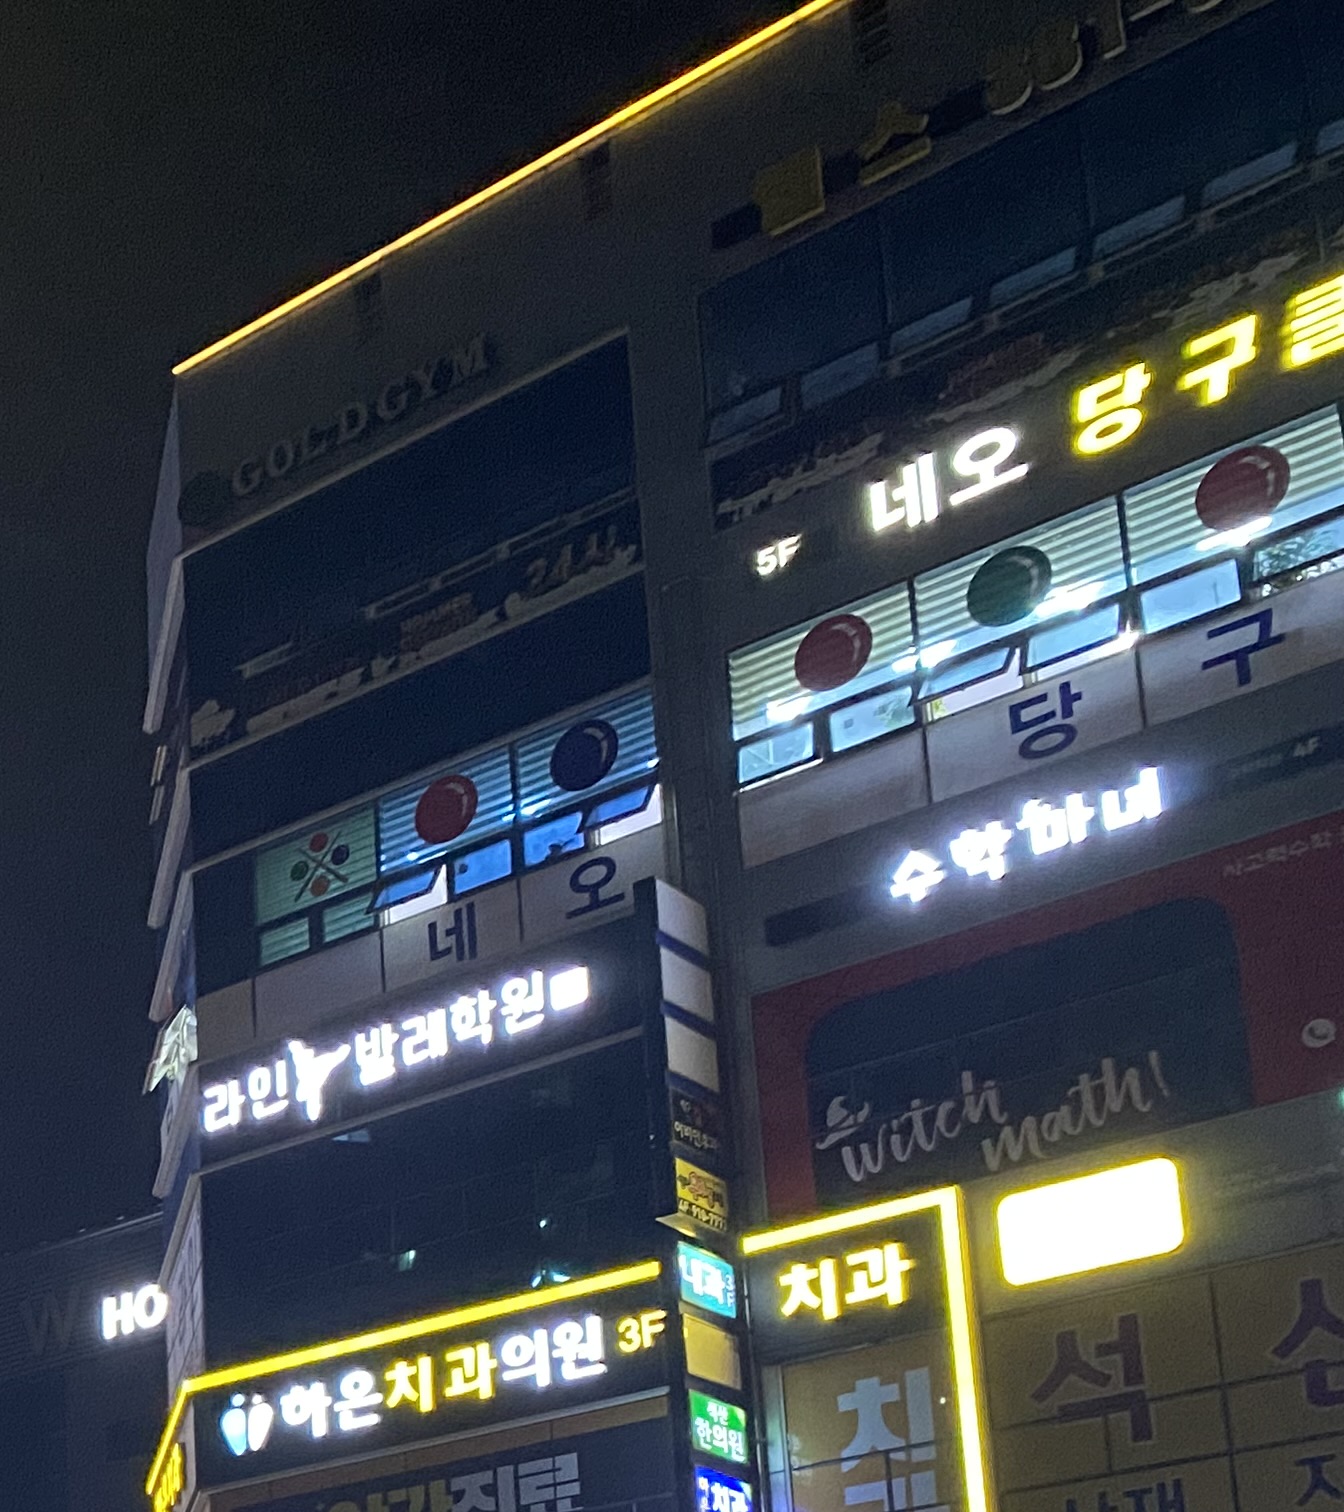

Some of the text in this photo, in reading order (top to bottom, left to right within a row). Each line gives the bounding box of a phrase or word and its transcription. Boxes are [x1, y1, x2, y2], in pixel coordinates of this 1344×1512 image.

[866, 424, 1030, 533] 네오
[755, 535, 803, 577] 5F
[202, 1058, 288, 1134] 라인
[354, 969, 546, 1087] 발레학원
[778, 1241, 916, 1321] 치과
[278, 1308, 667, 1439] 하은치과의원 3F
[694, 1416, 747, 1463] 한의원
